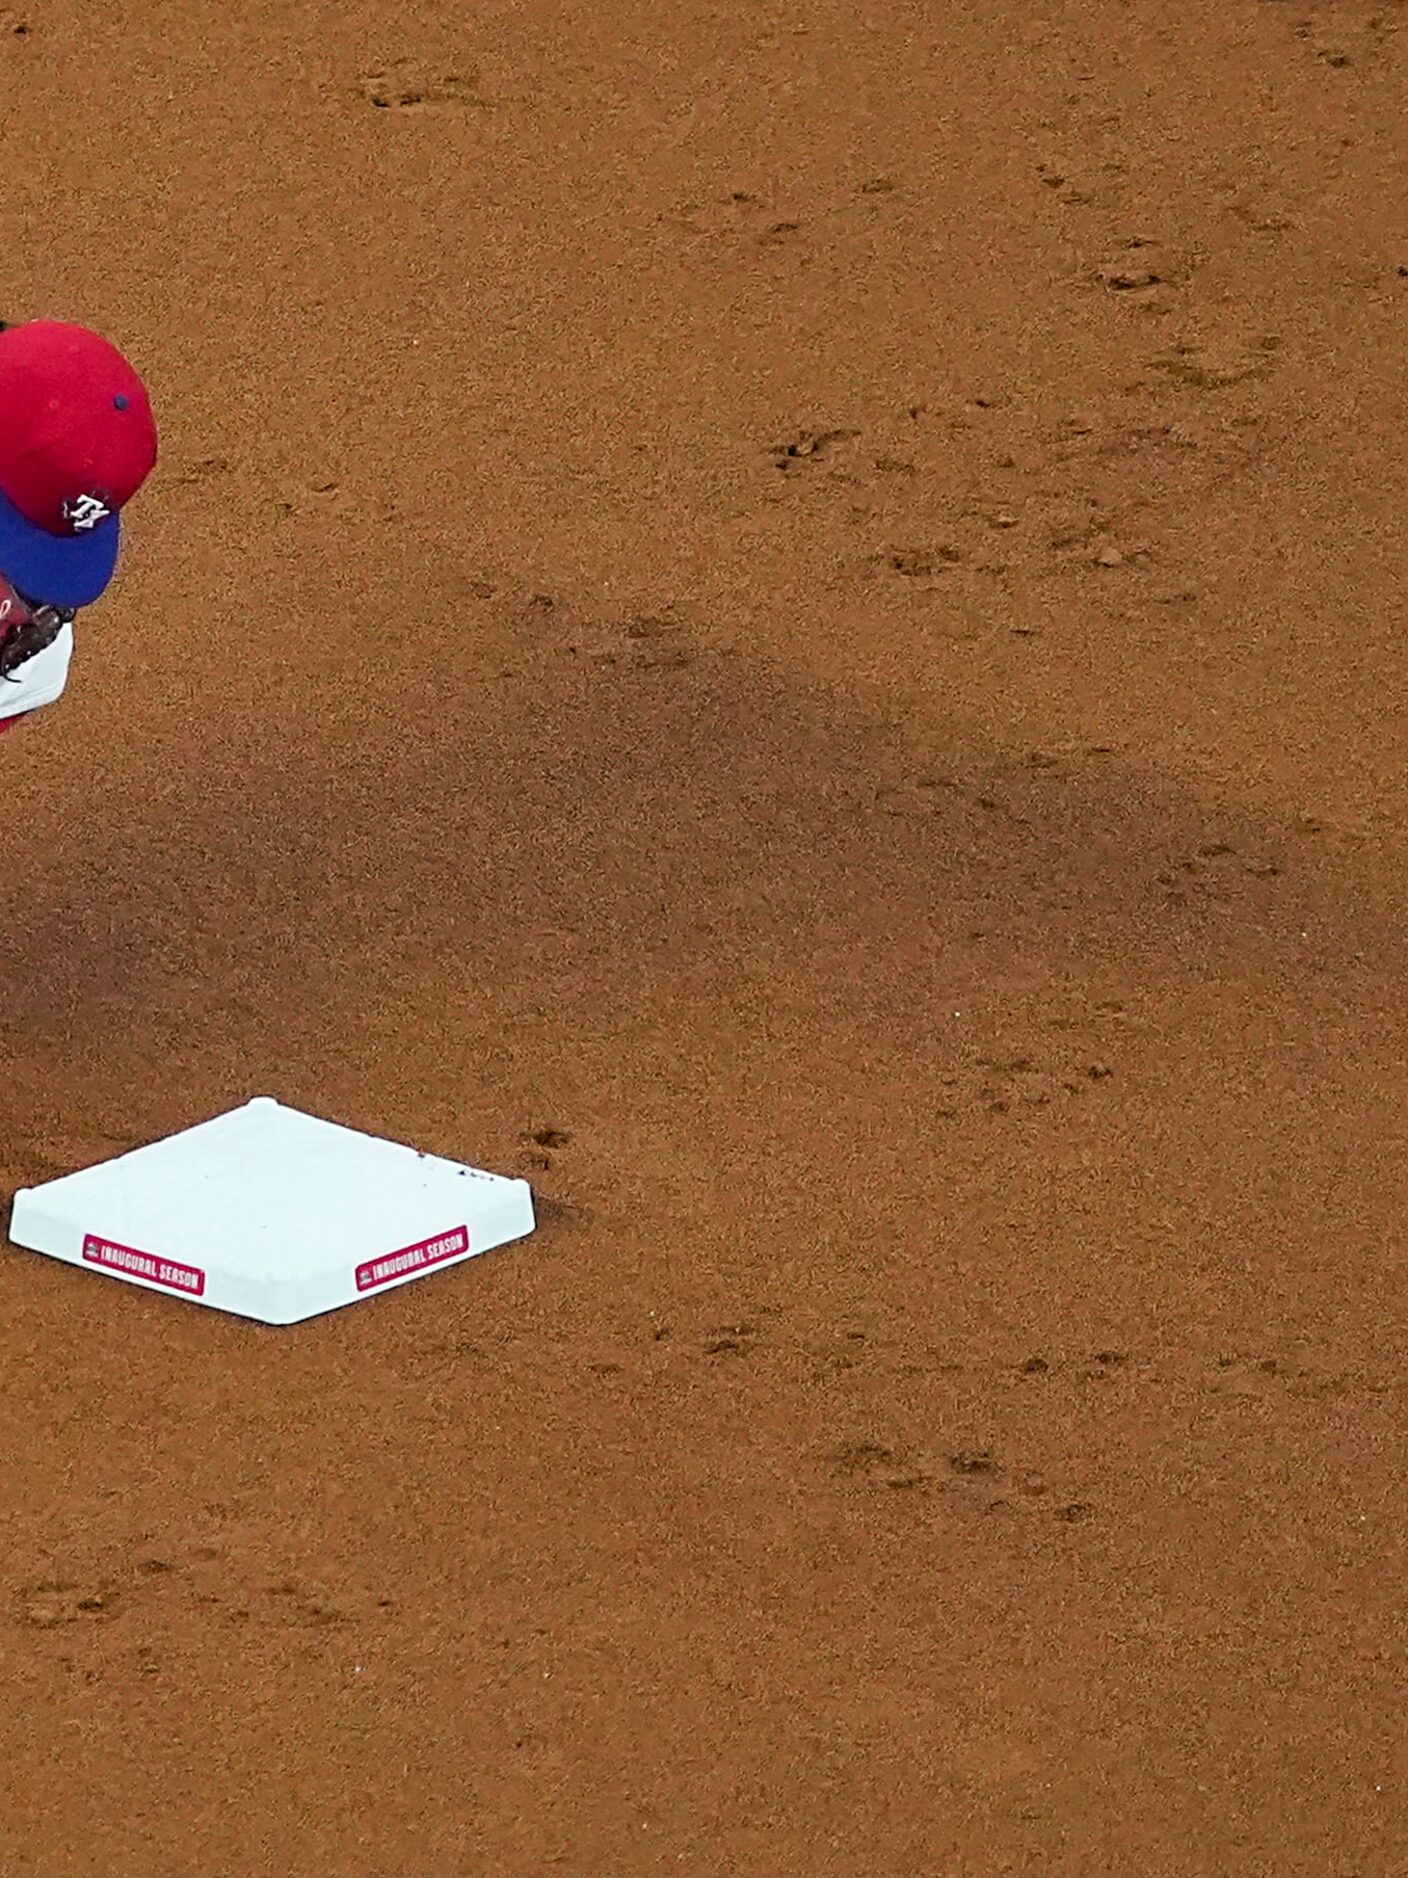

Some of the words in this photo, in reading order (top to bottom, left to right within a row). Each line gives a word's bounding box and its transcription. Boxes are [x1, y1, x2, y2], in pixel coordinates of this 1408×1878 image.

[100, 1244, 157, 1277] INAUGURAL
[159, 1263, 199, 1289] SEASON
[372, 1248, 426, 1281] INAUGURAL
[426, 1233, 464, 1260] SEASON
